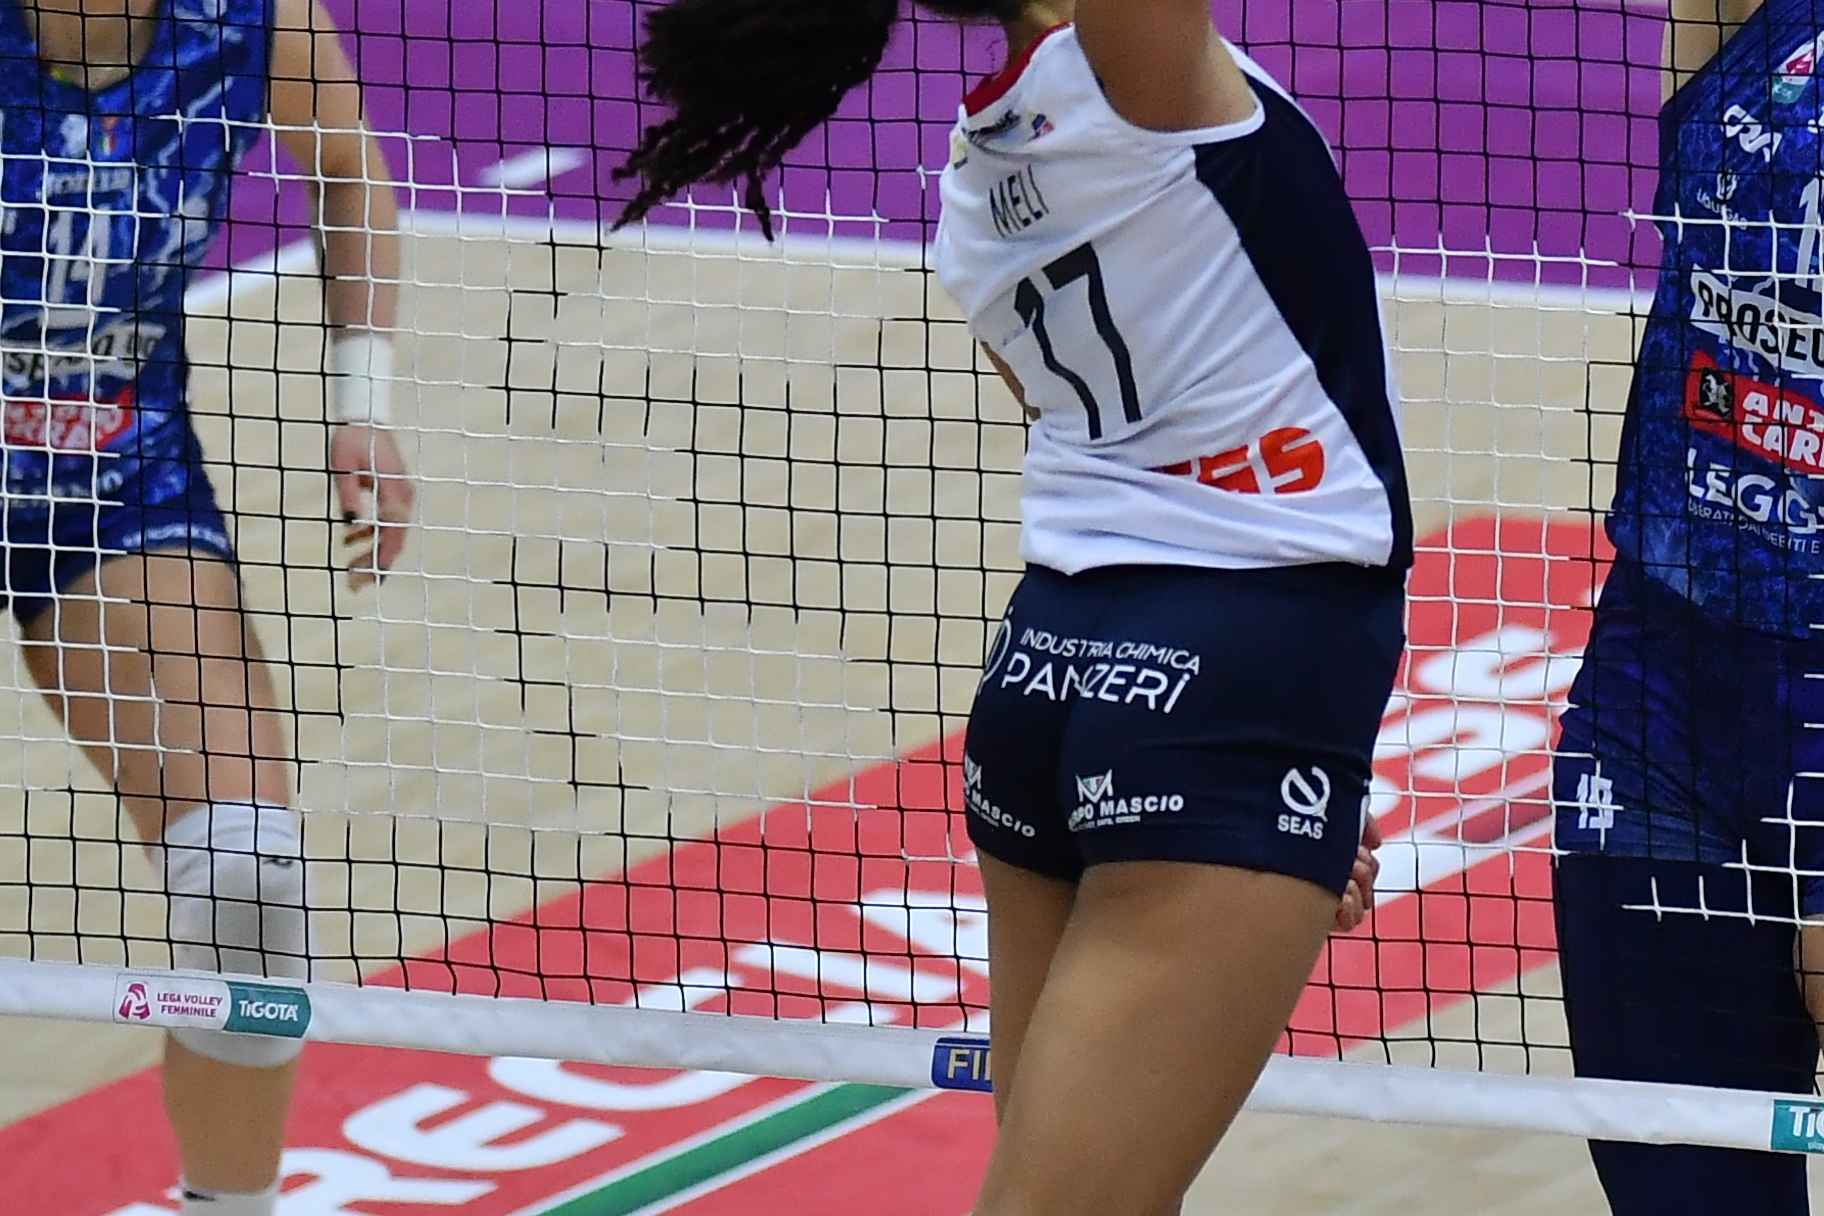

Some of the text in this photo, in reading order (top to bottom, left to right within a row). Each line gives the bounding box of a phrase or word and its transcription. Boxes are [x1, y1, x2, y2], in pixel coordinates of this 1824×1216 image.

[989, 165, 1050, 238] MELI
[1014, 241, 1143, 440] 17
[1020, 628, 1200, 676] INDUSTRIA CHIMICA
[971, 789, 1036, 837] MASCIO
[1100, 794, 1184, 817] MASCIO
[1278, 814, 1324, 841] SEAS
[157, 992, 224, 1007] LEGA VOLLEY
[160, 1004, 217, 1018] FEMMINILE
